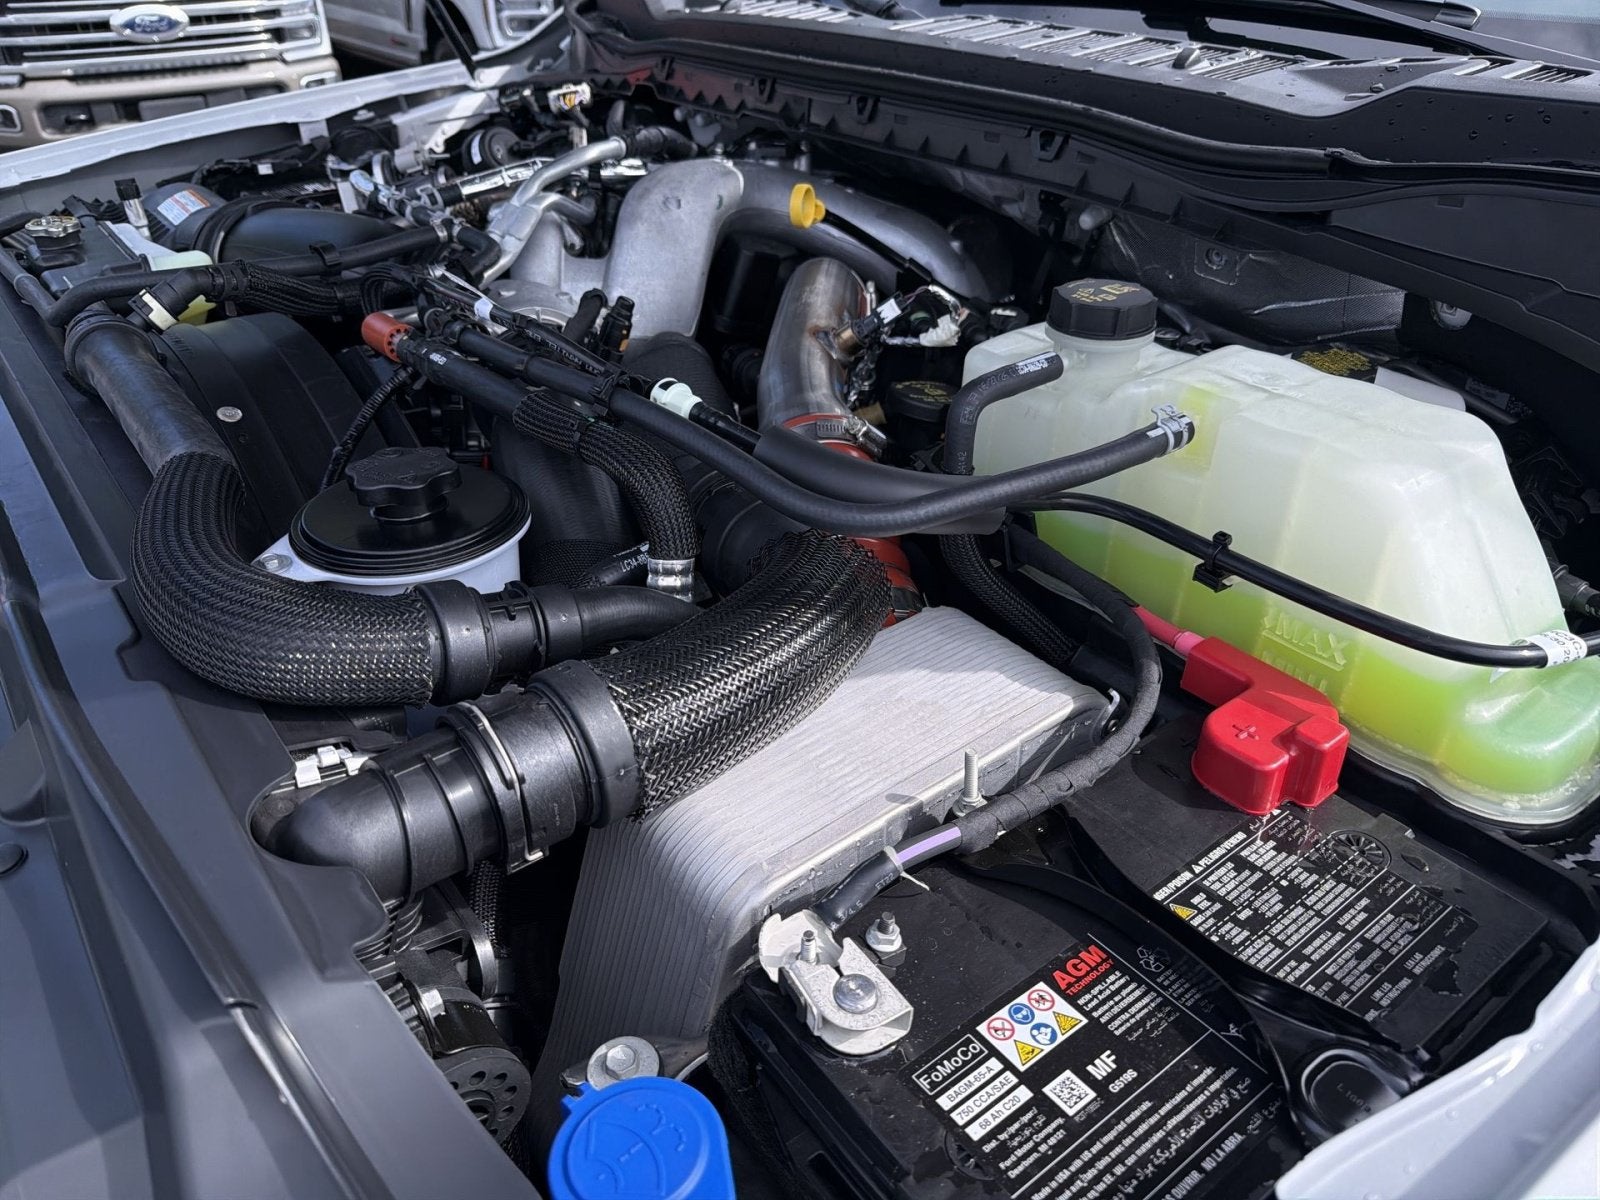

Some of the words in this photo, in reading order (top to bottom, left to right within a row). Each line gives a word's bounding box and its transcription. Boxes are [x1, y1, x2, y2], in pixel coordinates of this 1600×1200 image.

[1275, 612, 1350, 666] MAX
[1198, 831, 1247, 867] PELIGRO/VENENO
[1053, 945, 1106, 989] AGM
[1066, 960, 1112, 995] TECHNOLOGY
[1077, 970, 1121, 1005] NON-SPILLABLE
[1083, 997, 1100, 1011] Lead
[1097, 988, 1111, 1001] Acid
[1108, 975, 1130, 991] Battery
[1099, 1011, 1114, 1023] ANTI
[1107, 1012, 1131, 1031] CONTRA
[919, 1043, 980, 1089] FoMoCo
[1086, 1050, 1116, 1080] MF
[1108, 1068, 1137, 1093] G519S
[946, 1065, 995, 1102] BAGM-65-A
[956, 1104, 975, 1120] 750
[972, 1075, 1013, 1108] CCA/SAE
[978, 1118, 992, 1130] 68
[990, 1109, 1005, 1122] Ah
[1002, 1094, 1021, 1111] C20
[981, 1139, 1000, 1153] Dist.
[998, 1153, 1017, 1170] Ford
[1013, 1139, 1035, 1157] Motor
[1037, 1143, 1049, 1153] MI
[1046, 1129, 1066, 1146] 48121
[1048, 1180, 1059, 1189] in
[1054, 1168, 1071, 1183] USA
[1068, 1158, 1084, 1172] with
[1080, 1150, 1092, 1161] US
[1089, 1140, 1104, 1155] and
[1099, 1120, 1127, 1145] imported
[1121, 1135, 1135, 1147] des
[1200, 1156, 1217, 1171] NO
[1211, 1148, 1226, 1162] LA
[1221, 1132, 1245, 1153] ABRA.
[1124, 1153, 1137, 1166] con
